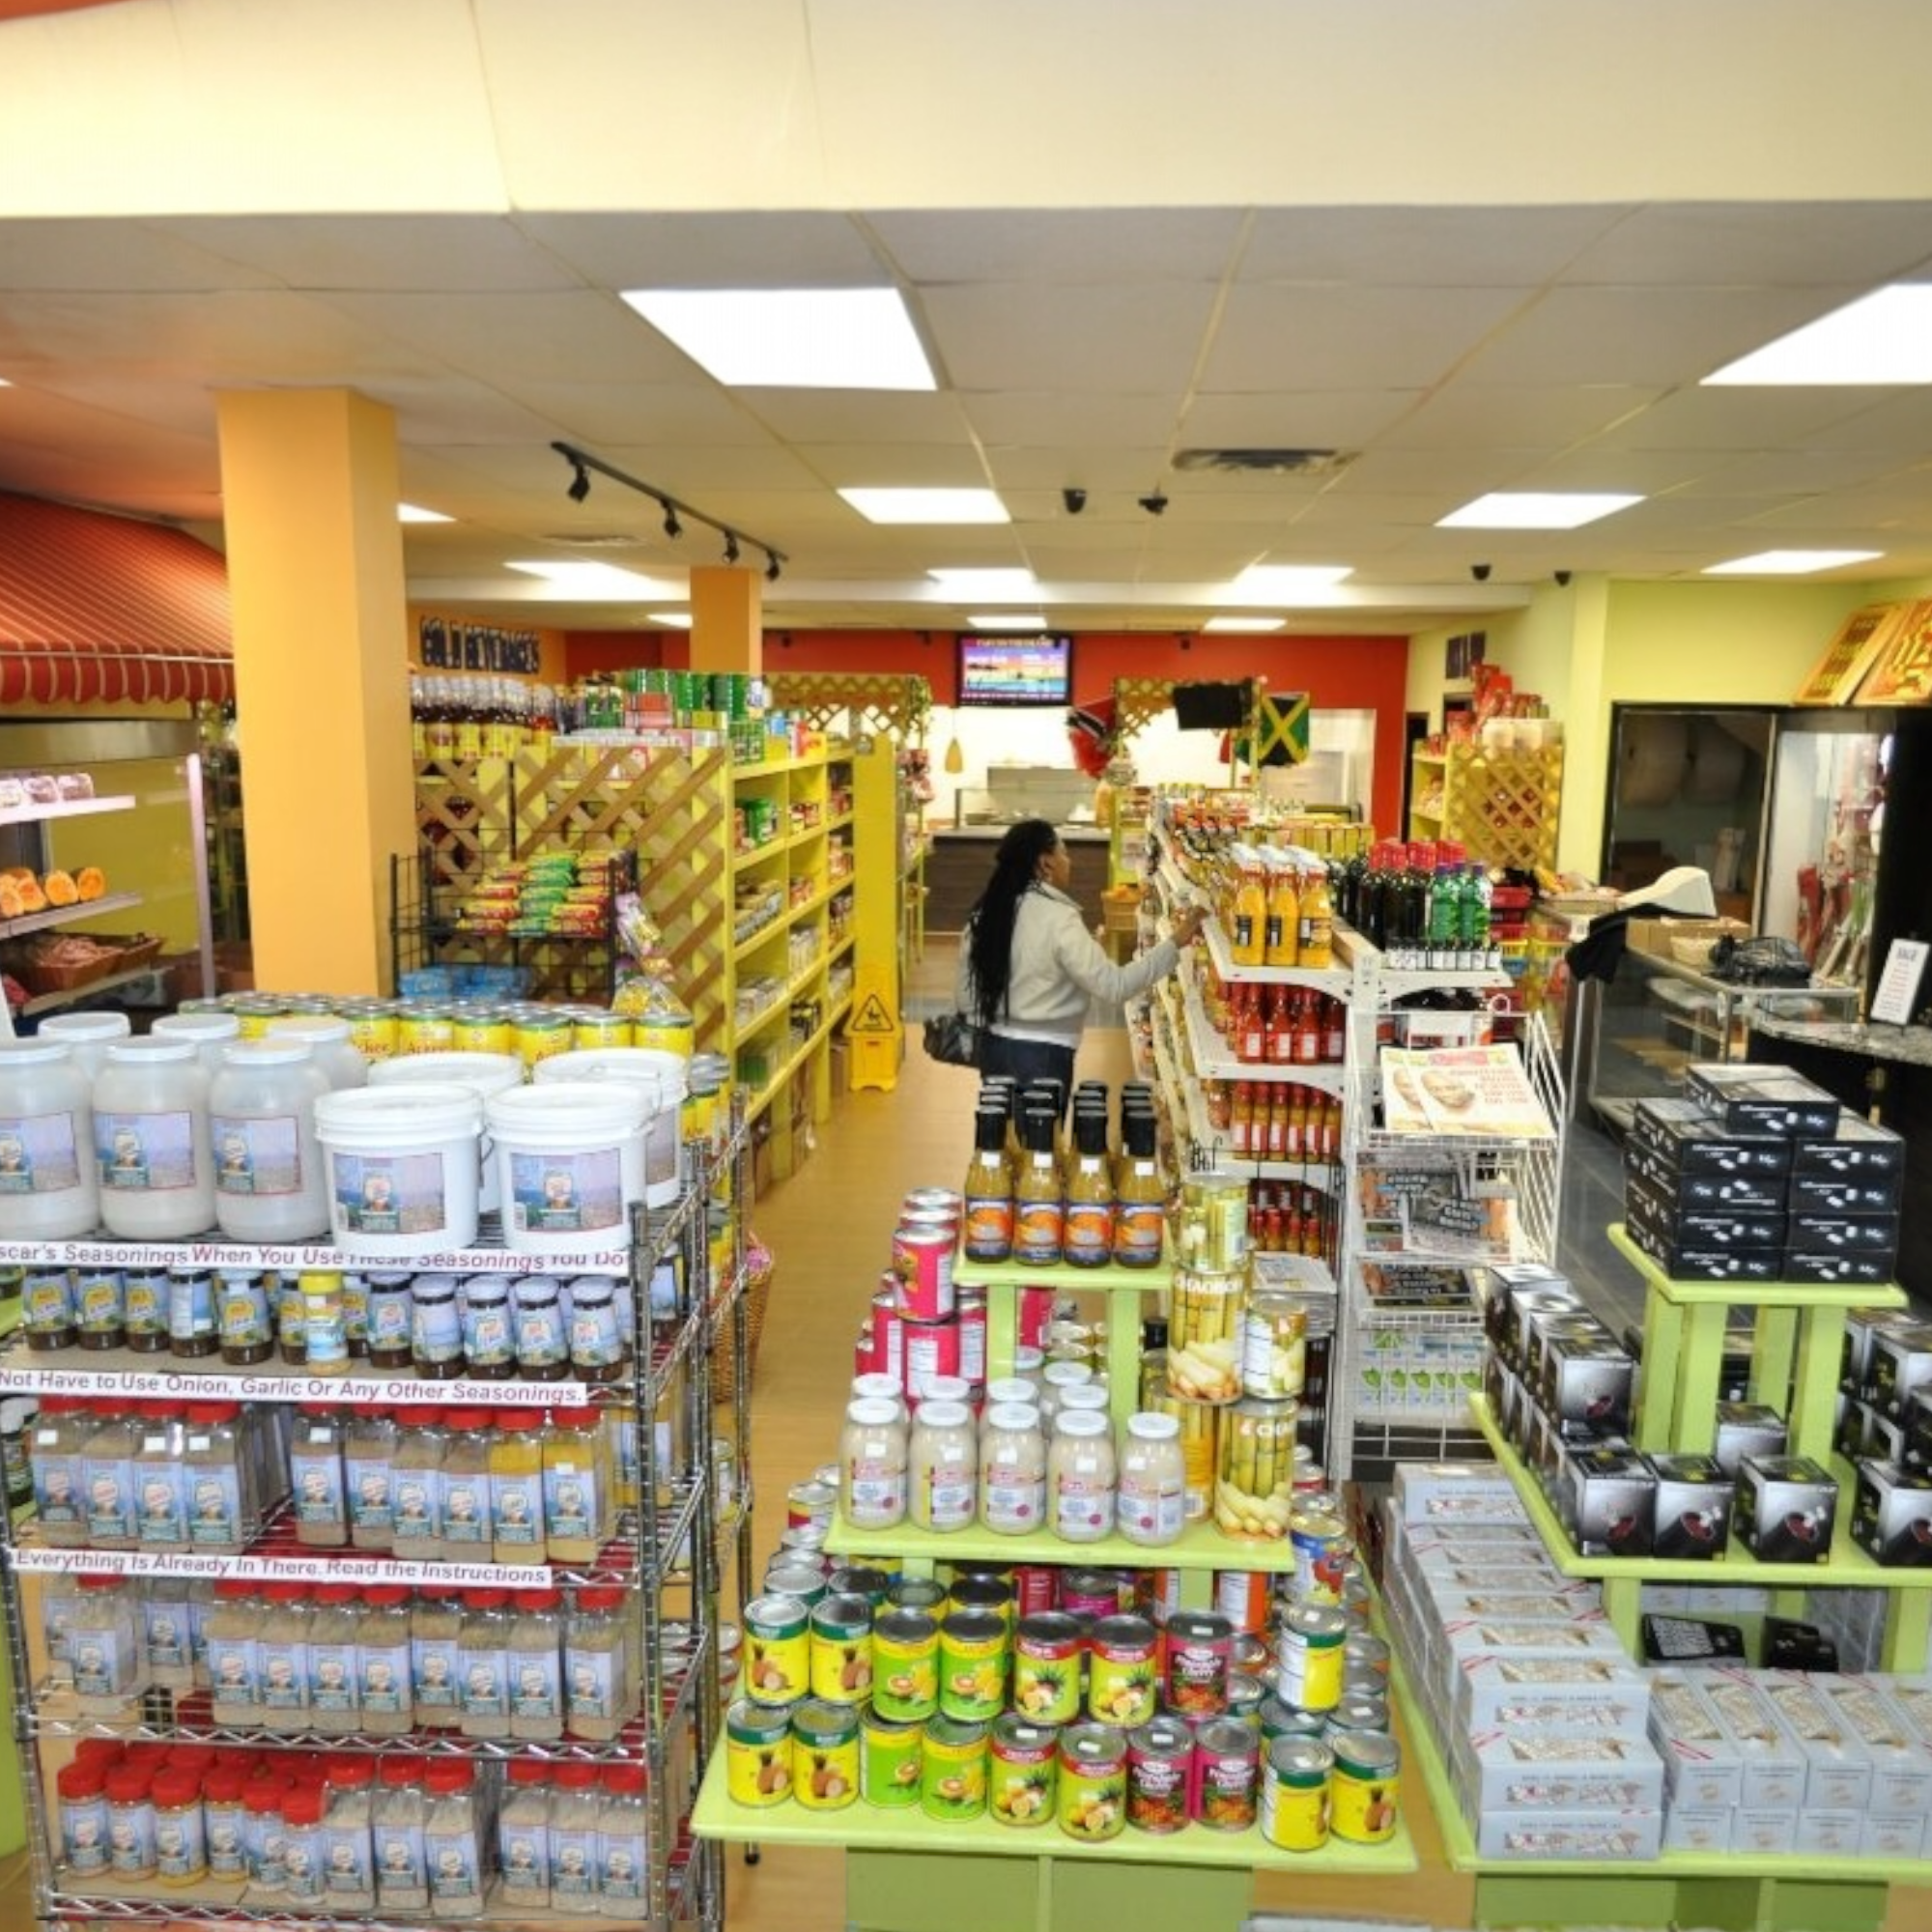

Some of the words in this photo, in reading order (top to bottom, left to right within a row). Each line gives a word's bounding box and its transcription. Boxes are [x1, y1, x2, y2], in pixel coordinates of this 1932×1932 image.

[65, 1245, 188, 1265] Seasonings
[192, 1246, 251, 1264] When
[258, 1247, 295, 1264] You
[302, 1247, 343, 1264] Use
[417, 1253, 544, 1273] Seasonings
[0, 1370, 32, 1386] Not
[40, 1371, 90, 1388] Have
[97, 1374, 116, 1389] to
[121, 1373, 159, 1390] Use
[166, 1375, 234, 1395] Onion,
[241, 1377, 301, 1395] Garlic
[307, 1379, 332, 1396] Or
[338, 1380, 380, 1402] Any
[386, 1381, 445, 1399] Other
[452, 1383, 582, 1403] Seasonings.
[16, 1550, 126, 1573] Everything
[131, 1554, 149, 1570] Is
[153, 1554, 229, 1577] Already
[237, 1556, 254, 1572] In
[327, 1557, 378, 1576] Read
[384, 1559, 415, 1577] the
[422, 1562, 546, 1582] Instructions
